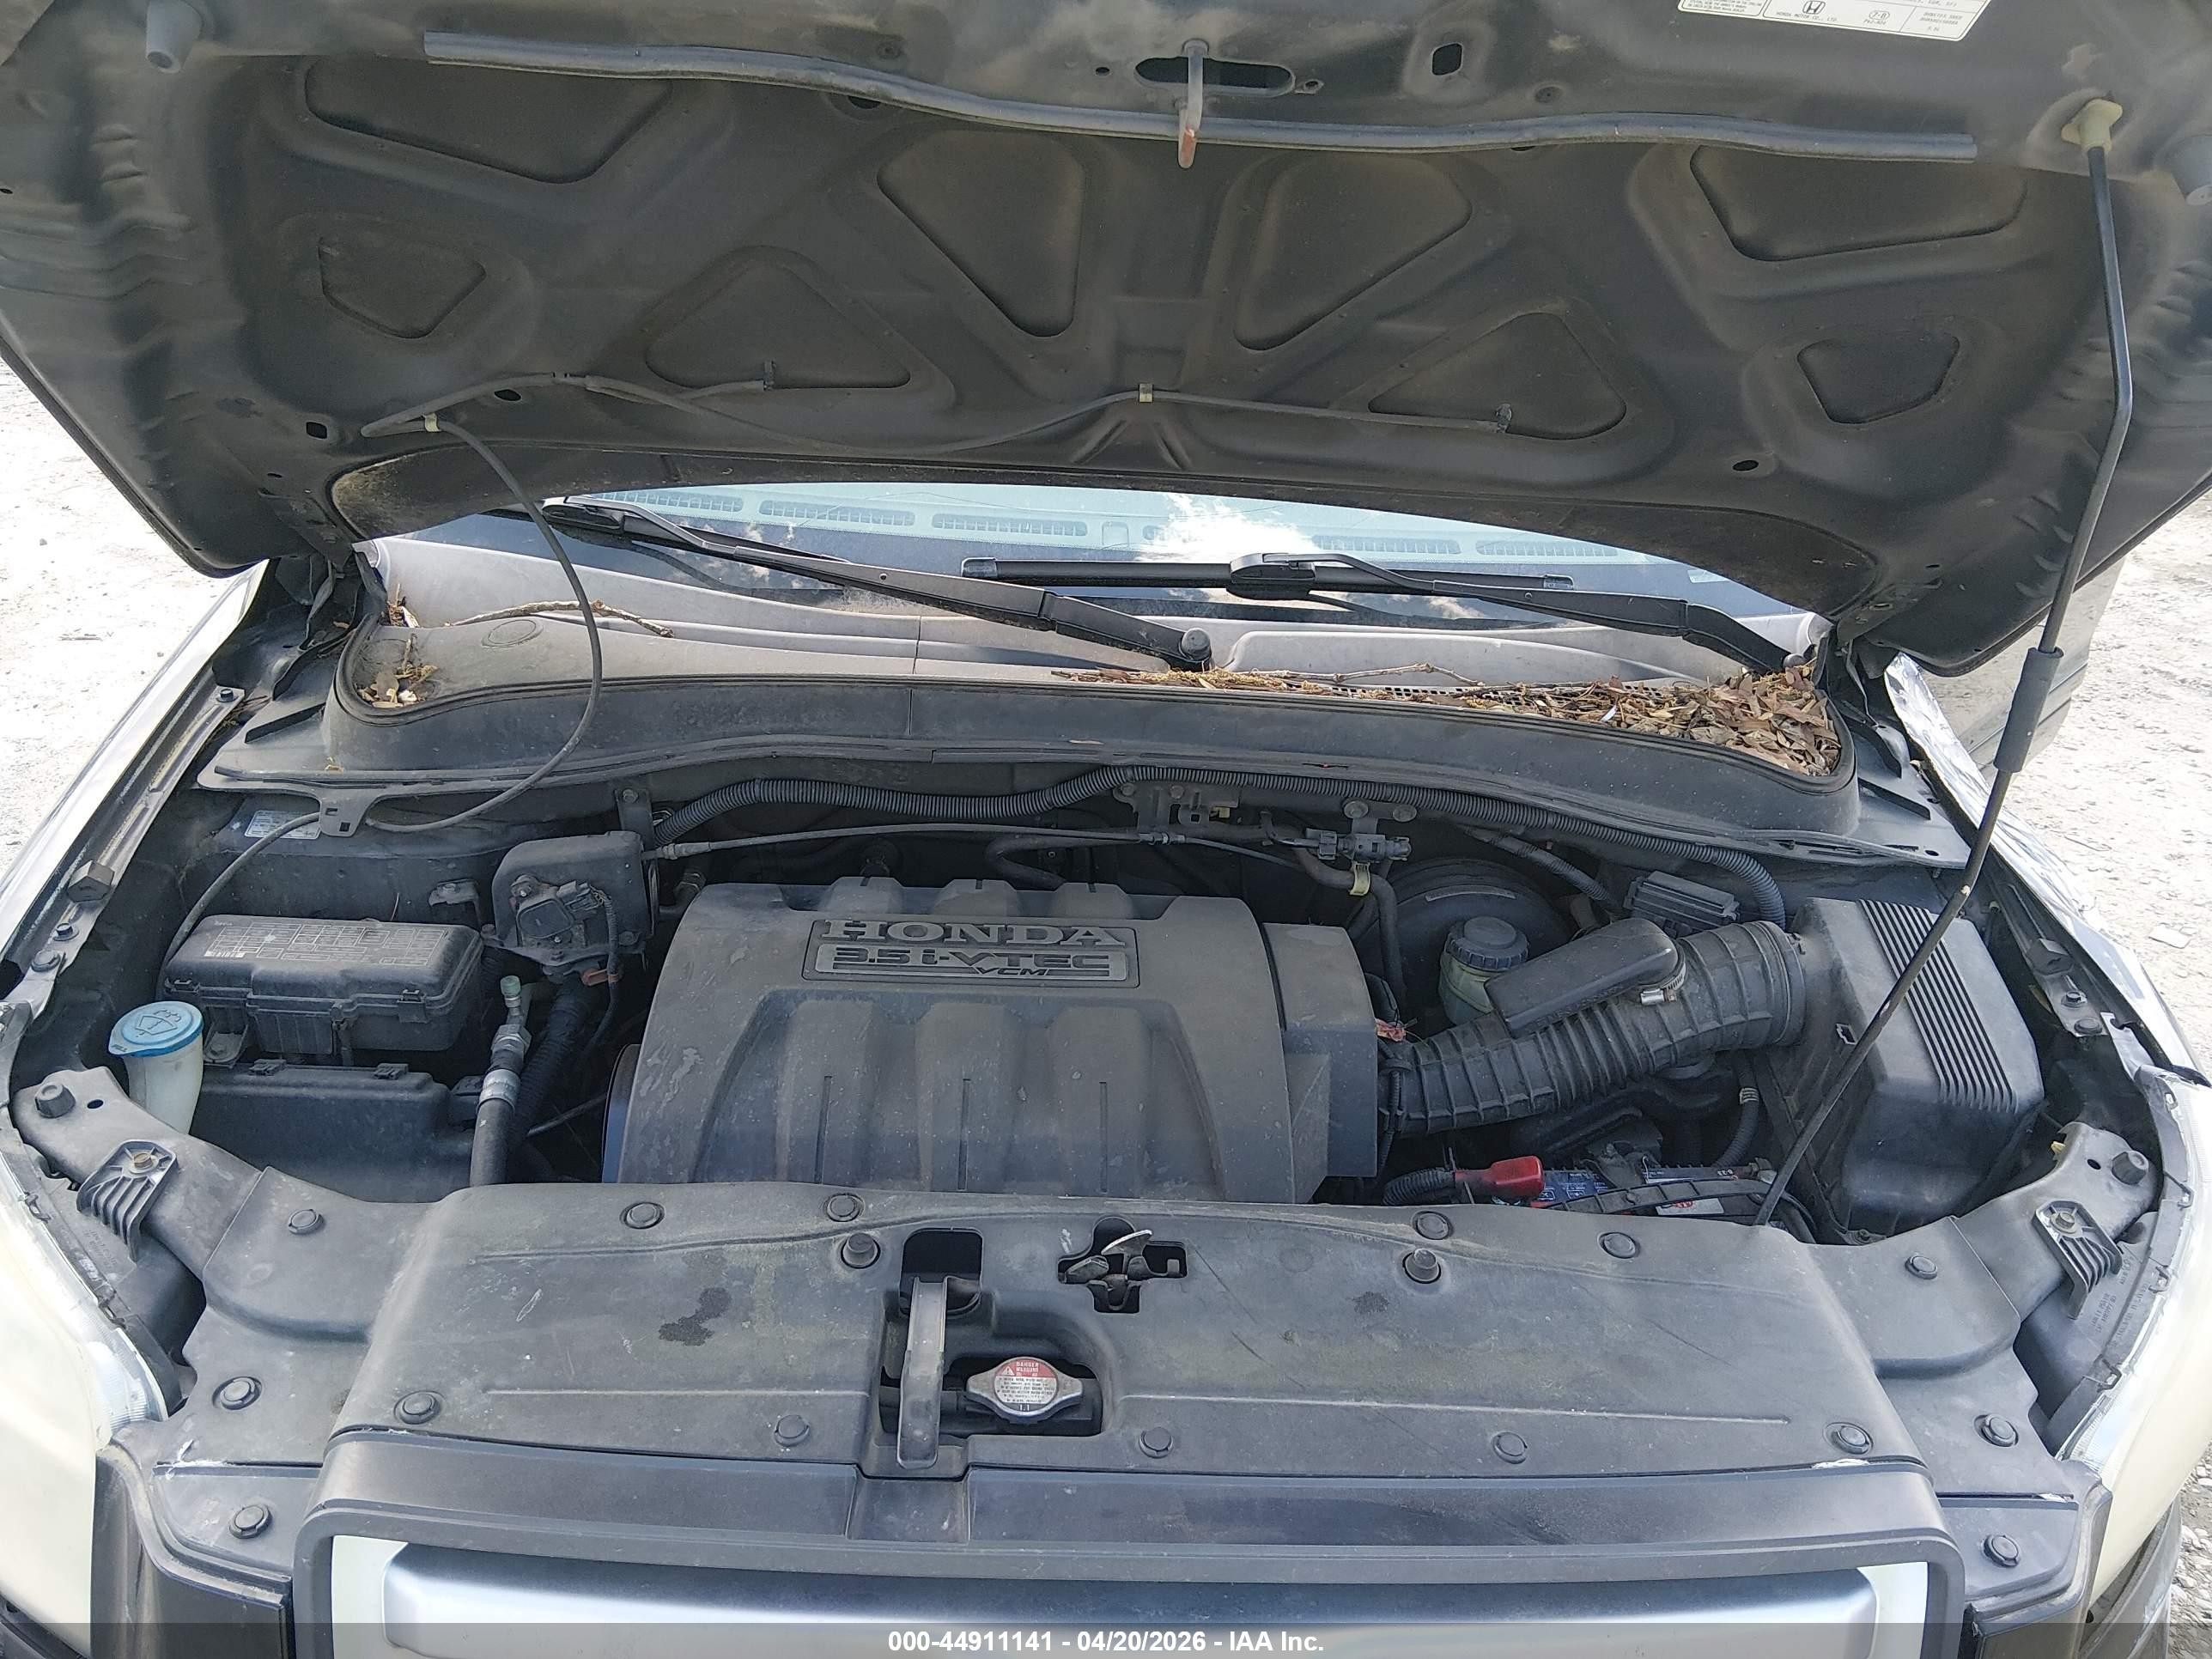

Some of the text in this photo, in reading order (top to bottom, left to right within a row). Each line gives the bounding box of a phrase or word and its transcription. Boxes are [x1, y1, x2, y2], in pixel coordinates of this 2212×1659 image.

[822, 919, 1126, 945] HONDA
[833, 947, 1110, 969] 3.5 i-VTEC
[974, 967, 1050, 976] VCM
